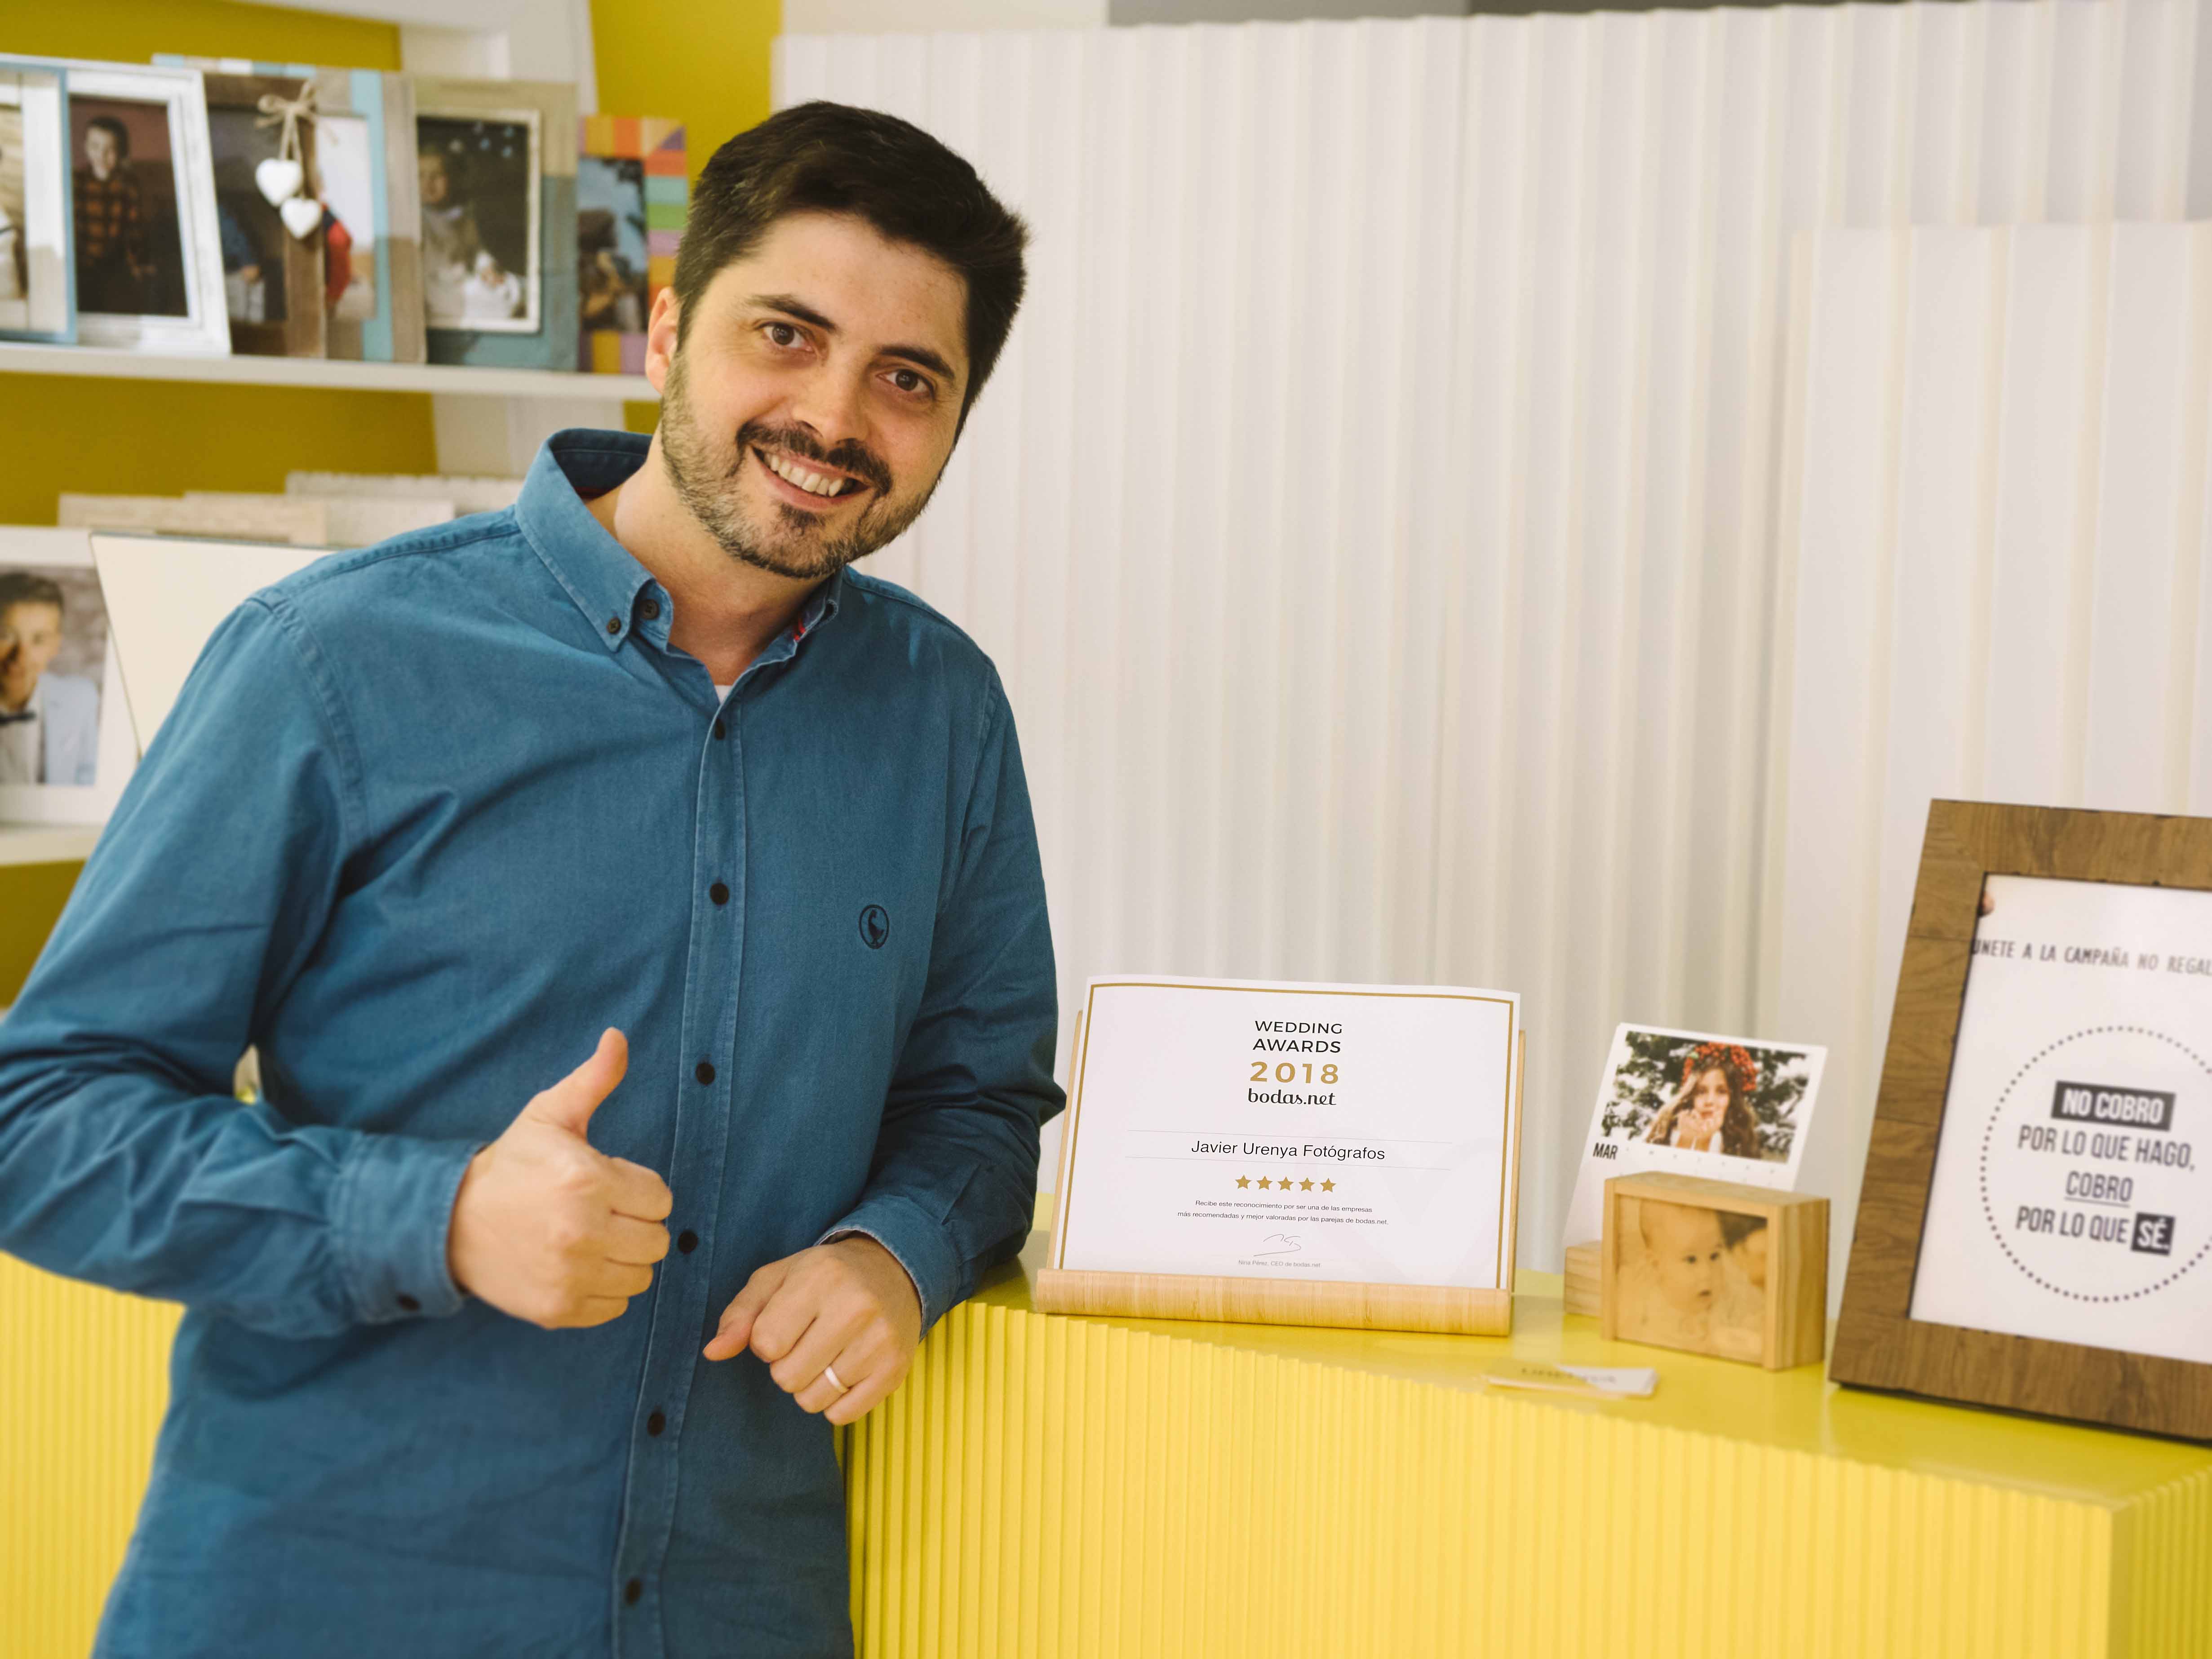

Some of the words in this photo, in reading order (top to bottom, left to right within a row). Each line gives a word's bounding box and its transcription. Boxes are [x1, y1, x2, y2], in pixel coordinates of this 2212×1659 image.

[2022, 943, 2032, 959] A
[2040, 944, 2056, 962] LA
[2064, 945, 2129, 967] CAMPAÑA
[2137, 953, 2159, 971] NO
[1255, 1020, 1342, 1034] WEDDING
[1253, 1038, 1341, 1053] AWARDS
[1250, 1061, 1339, 1084] 2018
[1248, 1088, 1337, 1105] bodas.net
[2061, 1088, 2092, 1116] NO
[2095, 1092, 2164, 1124] COBRO
[1191, 1140, 1238, 1154] Javier
[1243, 1142, 1298, 1159] Urenya
[1303, 1144, 1385, 1161] Fotógrafos
[1592, 1143, 1618, 1160] MAR
[2017, 1124, 2058, 1153] POR
[2062, 1130, 2086, 1156] LO
[2091, 1133, 2130, 1161] QUE
[2135, 1138, 2195, 1171] HAGO,
[2066, 1170, 2133, 1202] COBRO
[2015, 1205, 2055, 1233] POR
[2059, 1211, 2085, 1238] LO
[2089, 1214, 2129, 1243] QUE
